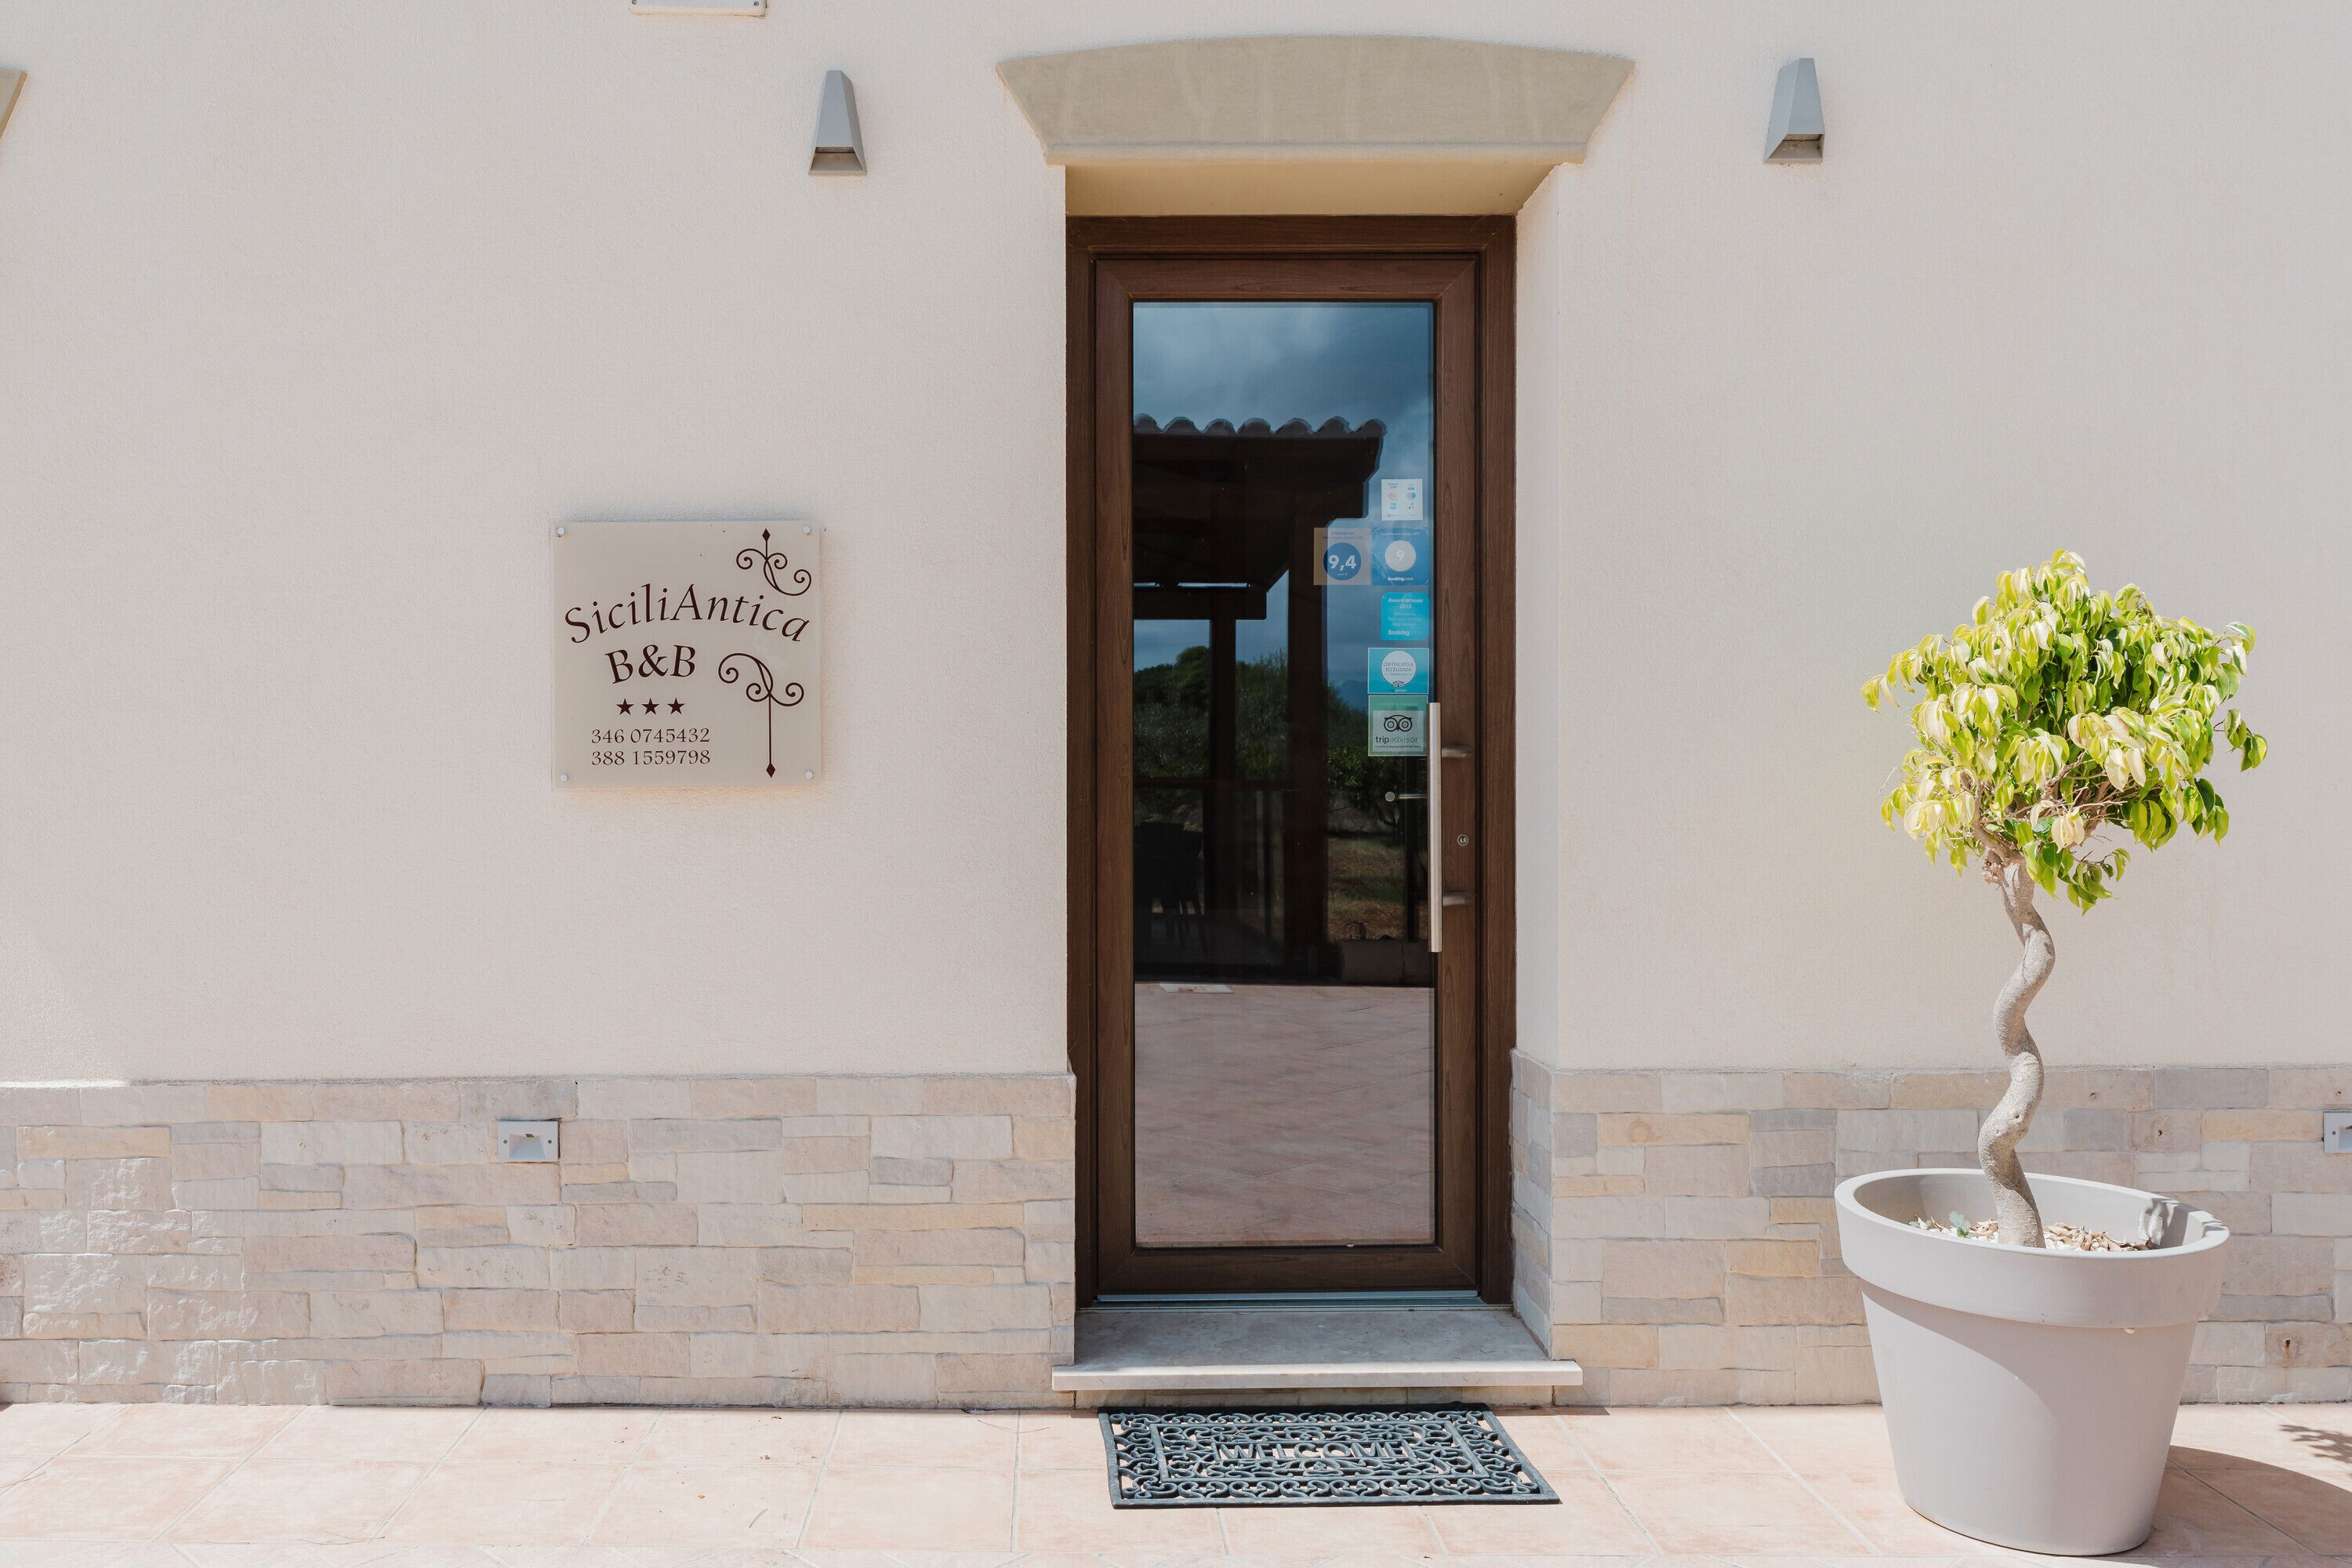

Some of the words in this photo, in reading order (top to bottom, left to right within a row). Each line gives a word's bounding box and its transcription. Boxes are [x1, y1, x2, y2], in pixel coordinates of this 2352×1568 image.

[1329, 554, 1357, 572] 9,4
[1396, 550, 1405, 561] 9
[564, 583, 810, 644] SiciliAntica
[604, 644, 696, 684] B&B
[591, 728, 624, 744] 346
[630, 728, 710, 743] 0745432
[1374, 735, 1419, 744] tripadvisor
[591, 750, 625, 766] 388
[633, 750, 710, 766] 1559798
[1220, 1442, 1407, 1459] WELCOME
